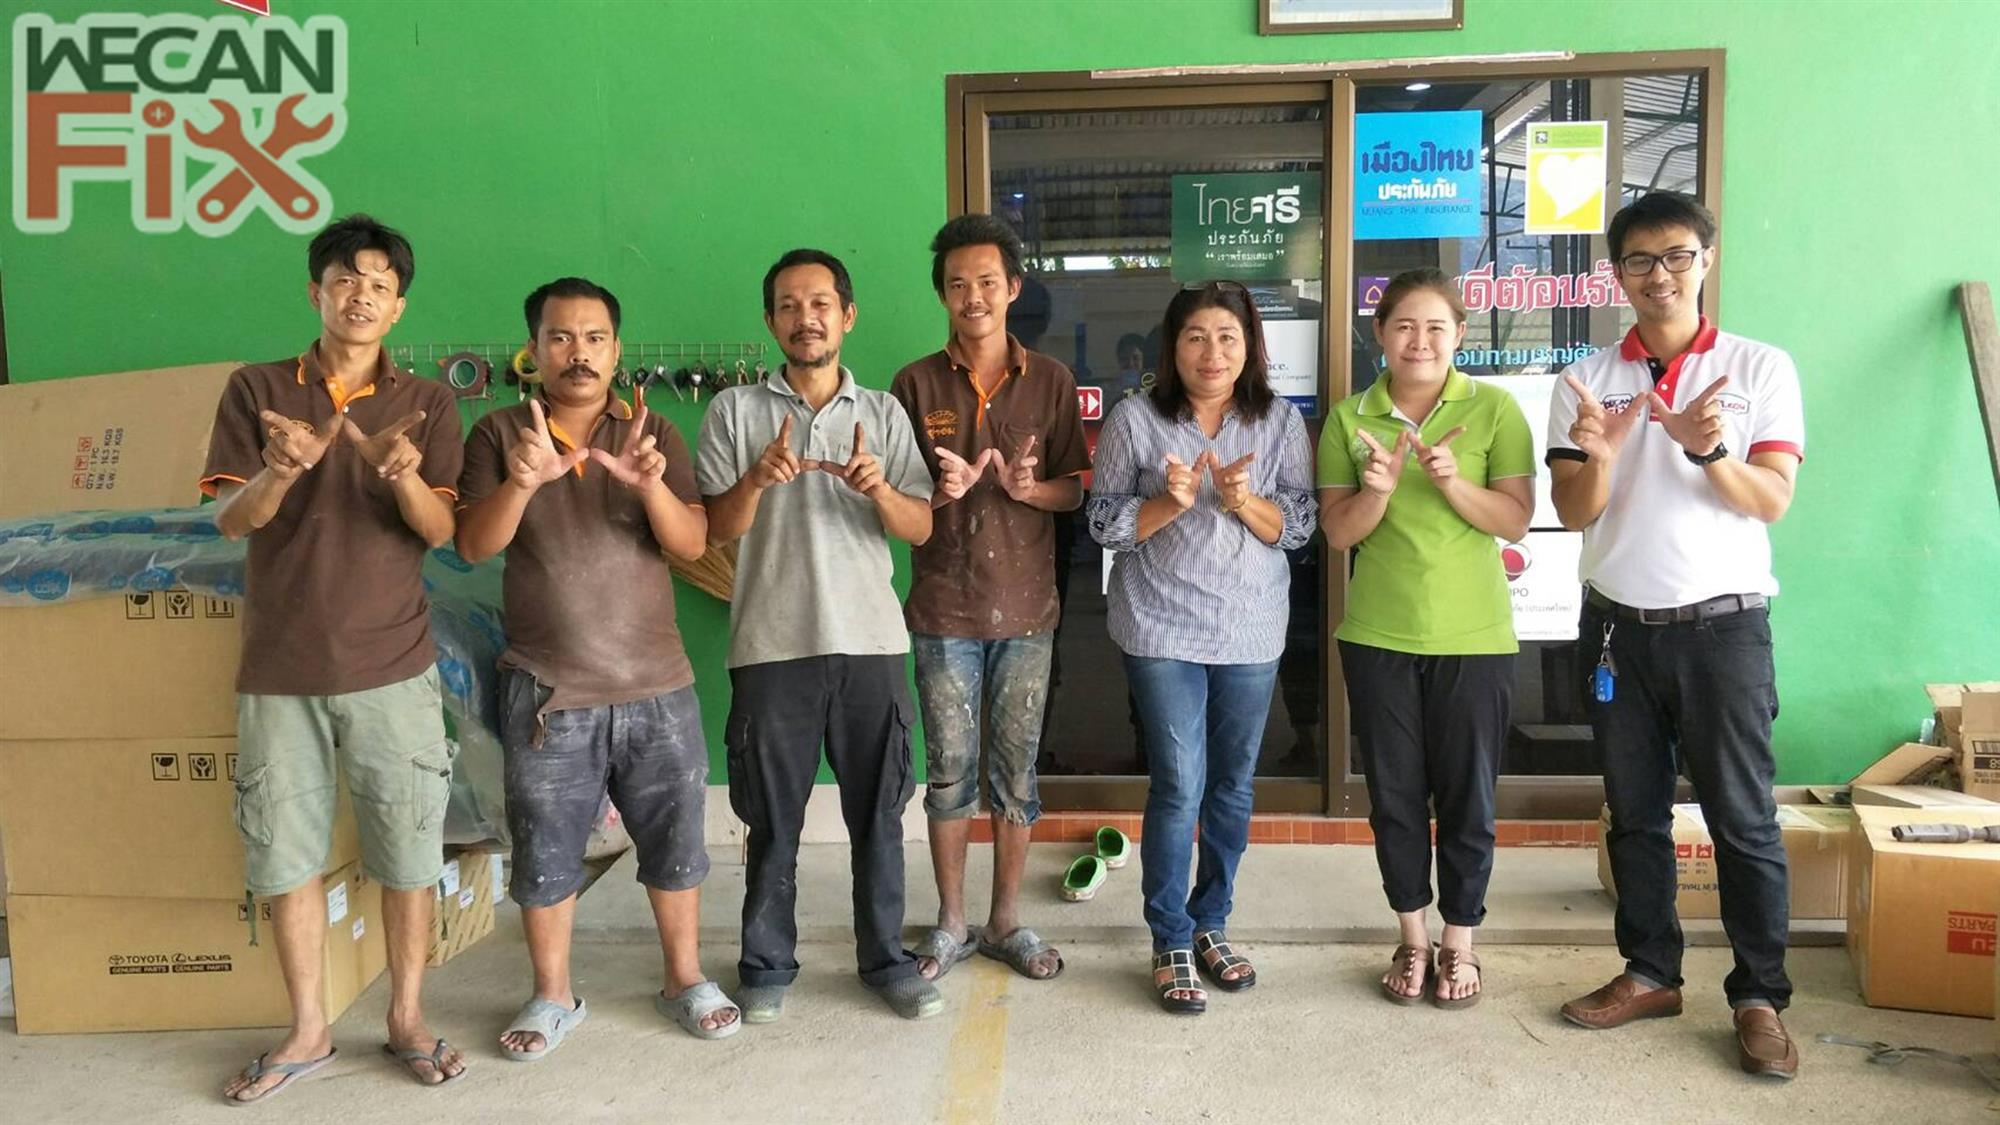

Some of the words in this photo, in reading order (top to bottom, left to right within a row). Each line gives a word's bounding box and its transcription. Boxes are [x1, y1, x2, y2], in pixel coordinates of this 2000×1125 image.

[1361, 141, 1474, 174] เมืองไทย
[1378, 178, 1457, 201] ประกันภัย
[1192, 183, 1301, 225] ไทยศรี
[1208, 228, 1284, 246] ประกันภัย
[1947, 917, 1996, 931] PARTS
[126, 955, 169, 964] TOYOTA
[188, 954, 232, 962] LEXUS
[143, 965, 167, 973] PARTS
[206, 963, 230, 971] PARTS
